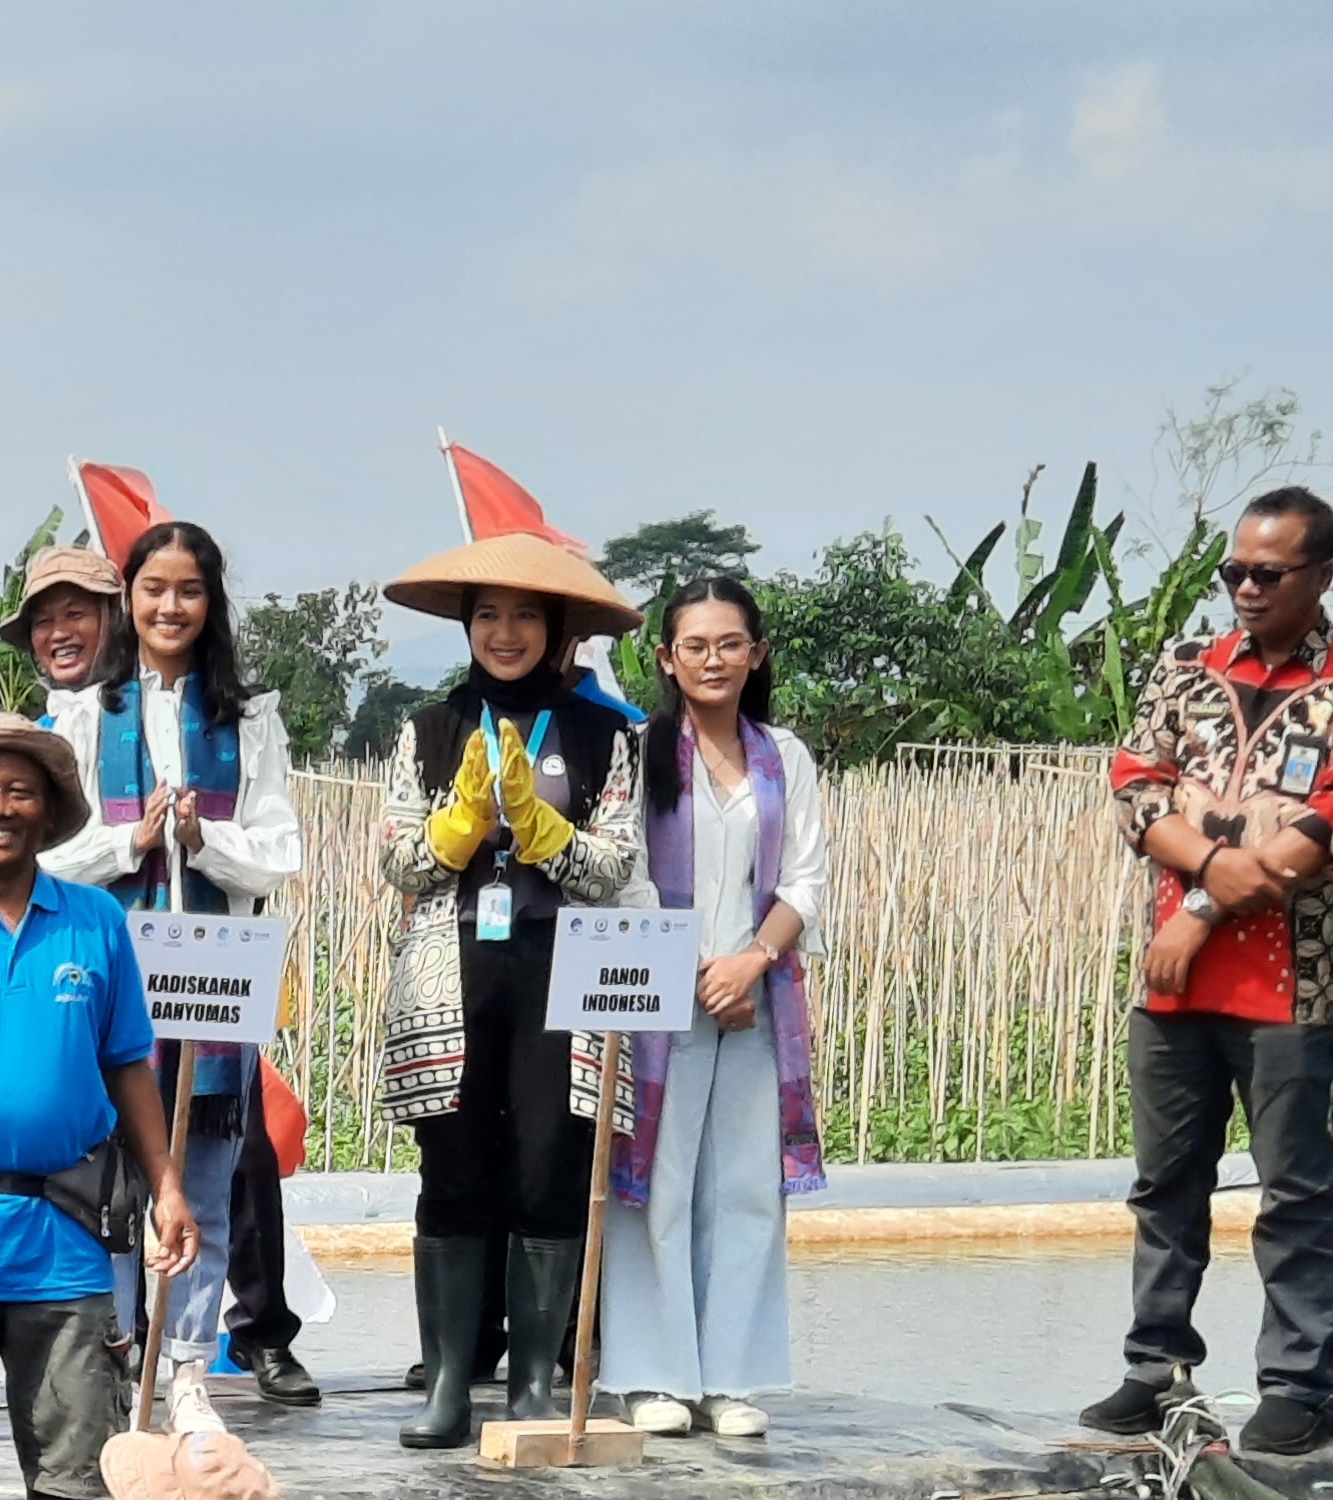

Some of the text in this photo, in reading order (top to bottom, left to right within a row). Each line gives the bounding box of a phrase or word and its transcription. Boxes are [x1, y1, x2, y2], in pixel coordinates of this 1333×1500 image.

[147, 973, 253, 998] KADISKANAK
[151, 1000, 242, 1024] BANYUMAS
[582, 993, 661, 1013] INDONESIA
